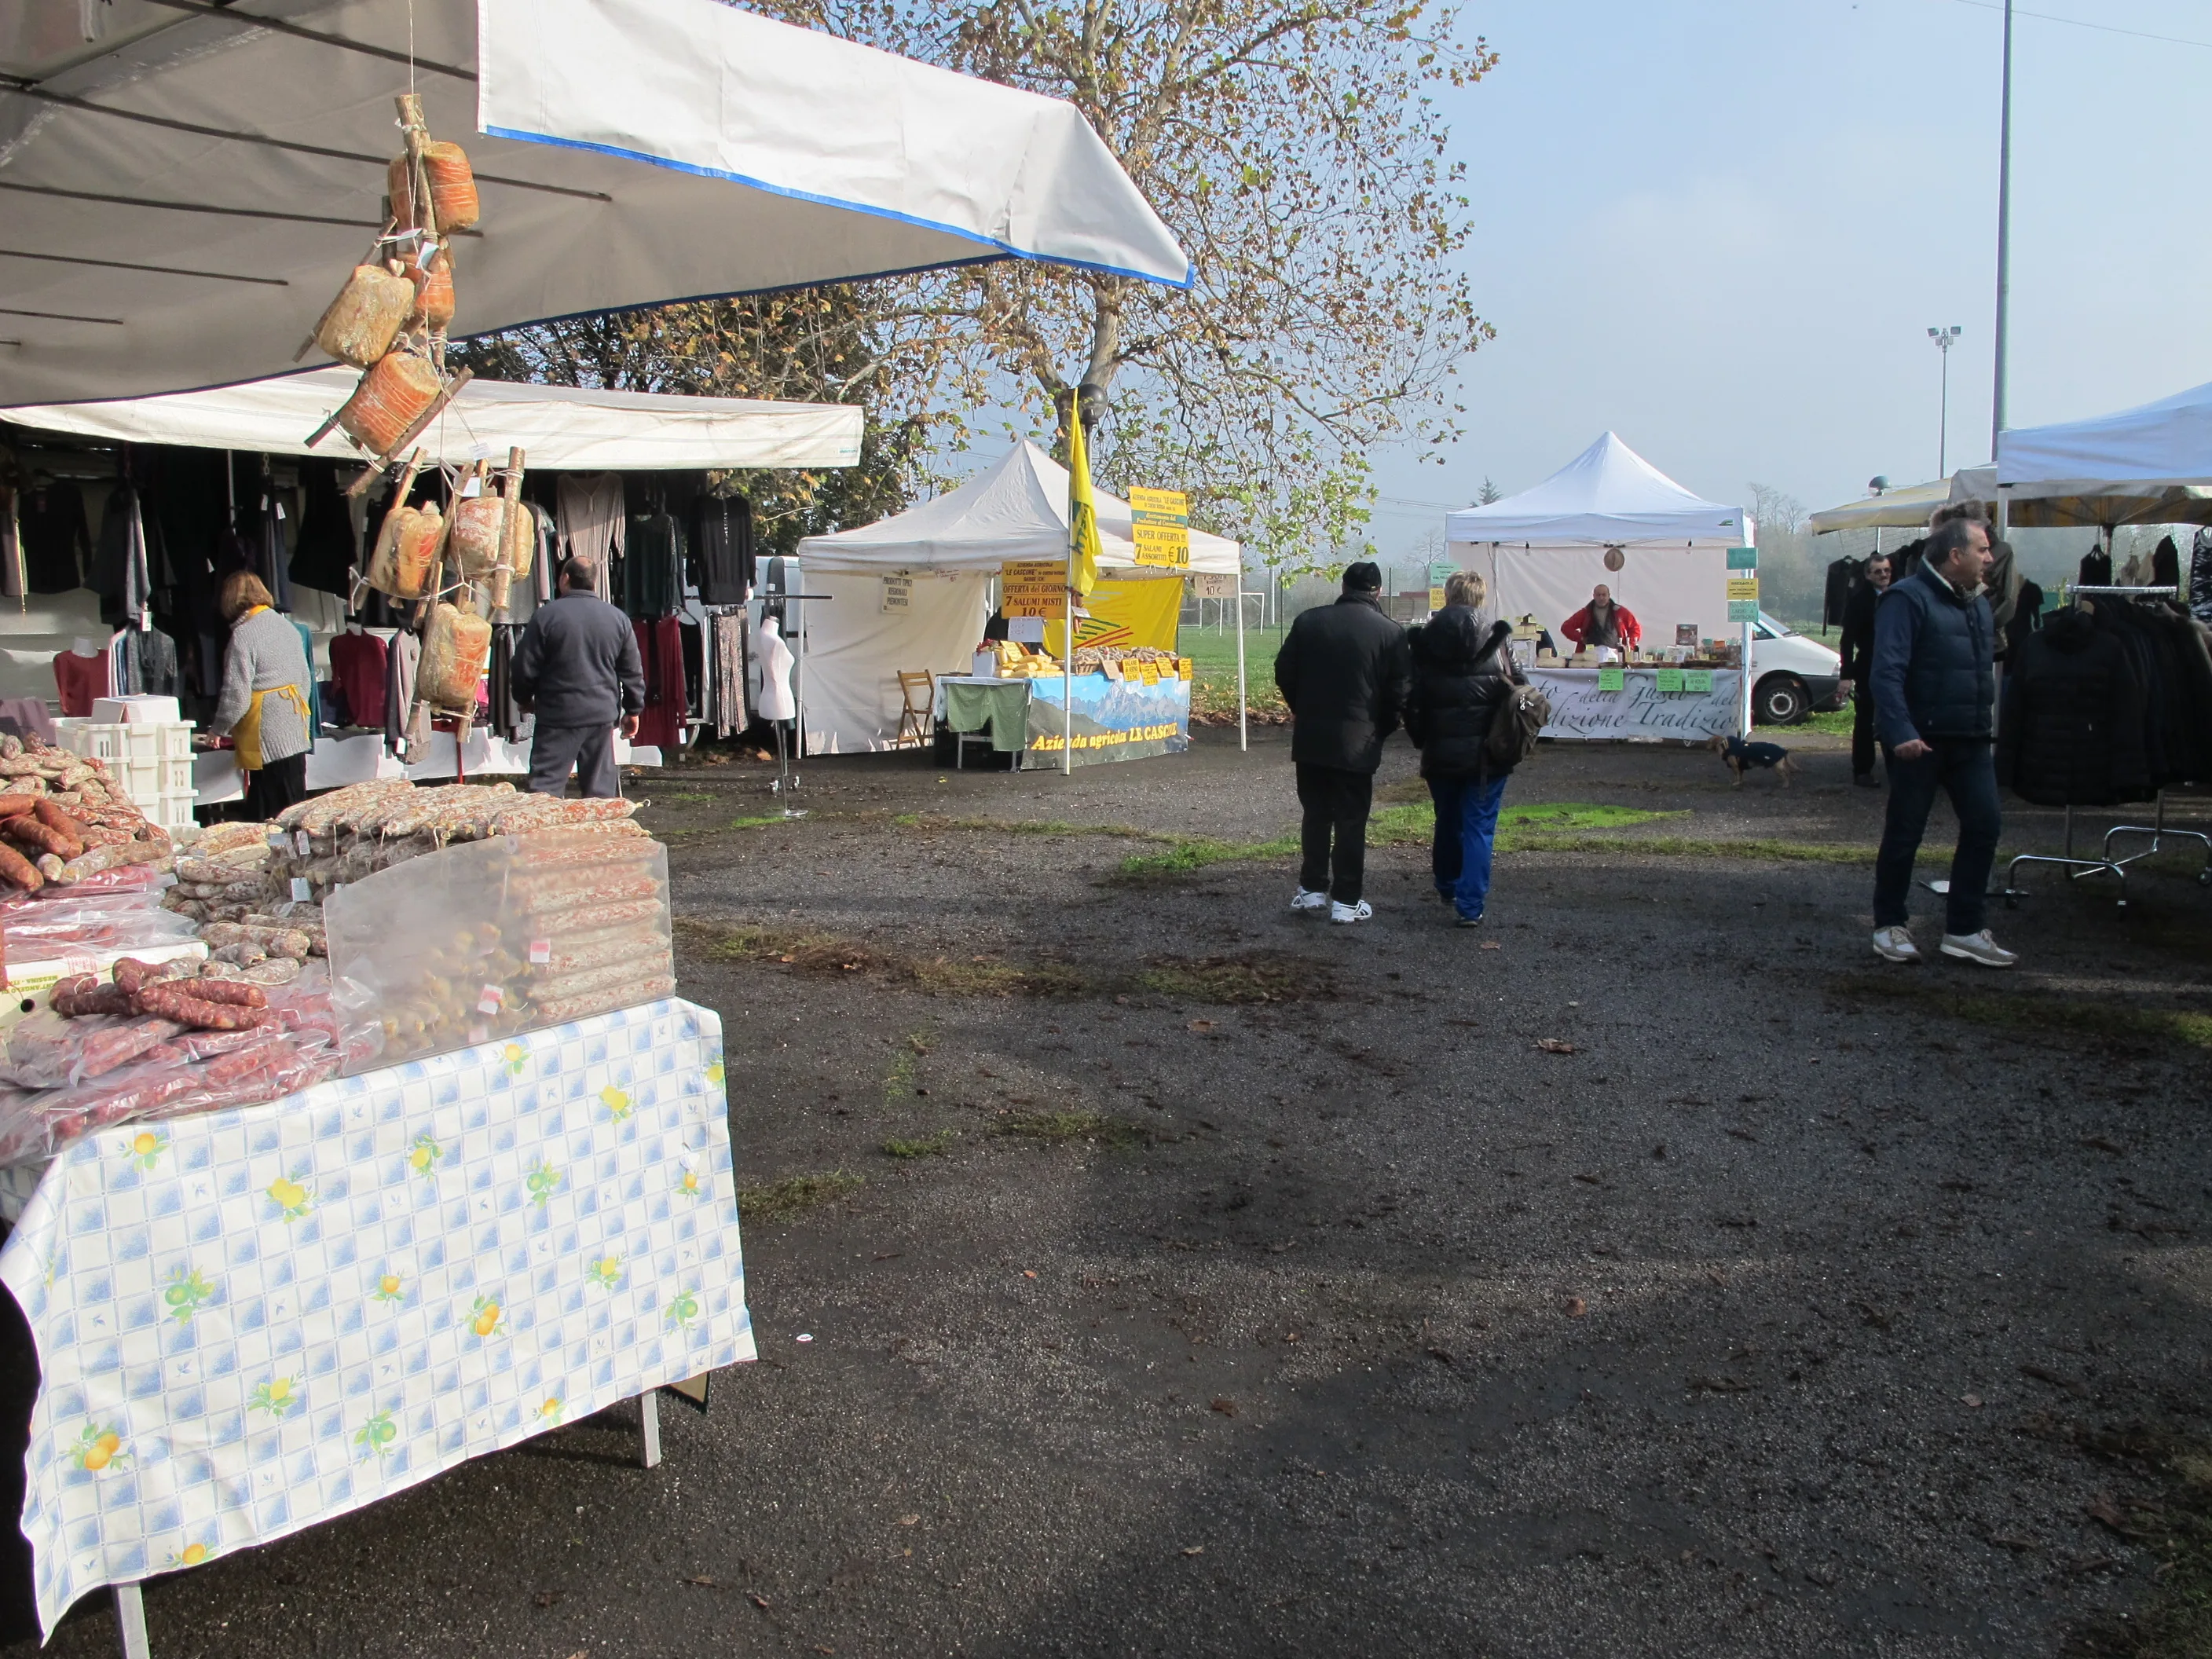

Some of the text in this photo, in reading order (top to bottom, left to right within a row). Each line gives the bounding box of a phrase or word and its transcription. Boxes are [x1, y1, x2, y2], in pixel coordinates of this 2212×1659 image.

[1137, 529, 1155, 540] SUPER
[1156, 531, 1180, 541] OFFERTA
[1136, 543, 1142, 559] 7
[1003, 584, 1029, 593] OFFERTA
[1041, 584, 1066, 593] GIORNO
[1206, 586, 1214, 595] 10
[1006, 595, 1013, 606] 7
[1022, 607, 1036, 617] 10
[1579, 677, 1619, 705] della
[1547, 692, 1627, 734] dizione
[1636, 694, 1739, 736] Tradizion
[1090, 729, 1127, 749] agricola
[1128, 727, 1142, 742] LE
